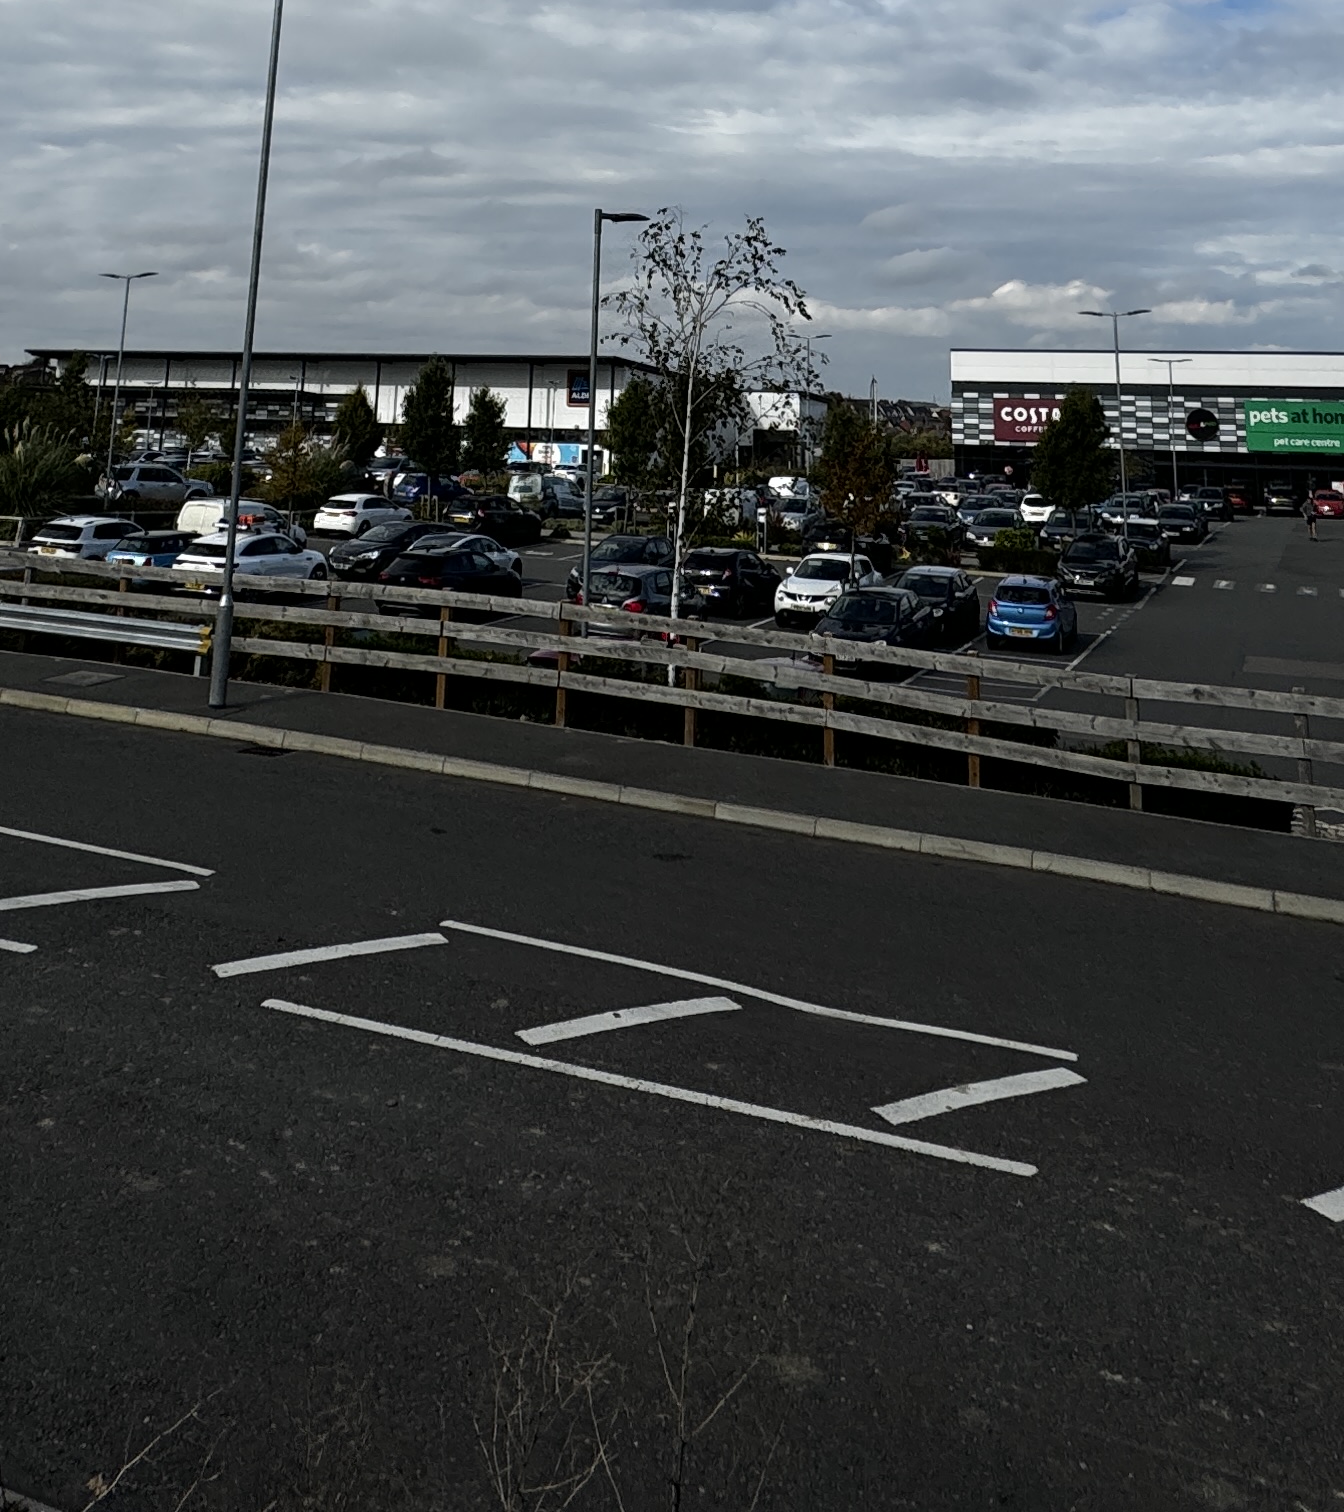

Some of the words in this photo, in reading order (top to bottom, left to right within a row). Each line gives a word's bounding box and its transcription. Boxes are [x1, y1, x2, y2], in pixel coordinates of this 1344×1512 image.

[571, 391, 590, 400] ALDI
[1000, 406, 1061, 424] COSTA
[1249, 407, 1289, 426] pets
[1291, 408, 1309, 424] at
[1273, 437, 1289, 447] pet
[1290, 438, 1310, 447] care
[1311, 438, 1340, 448] centre
